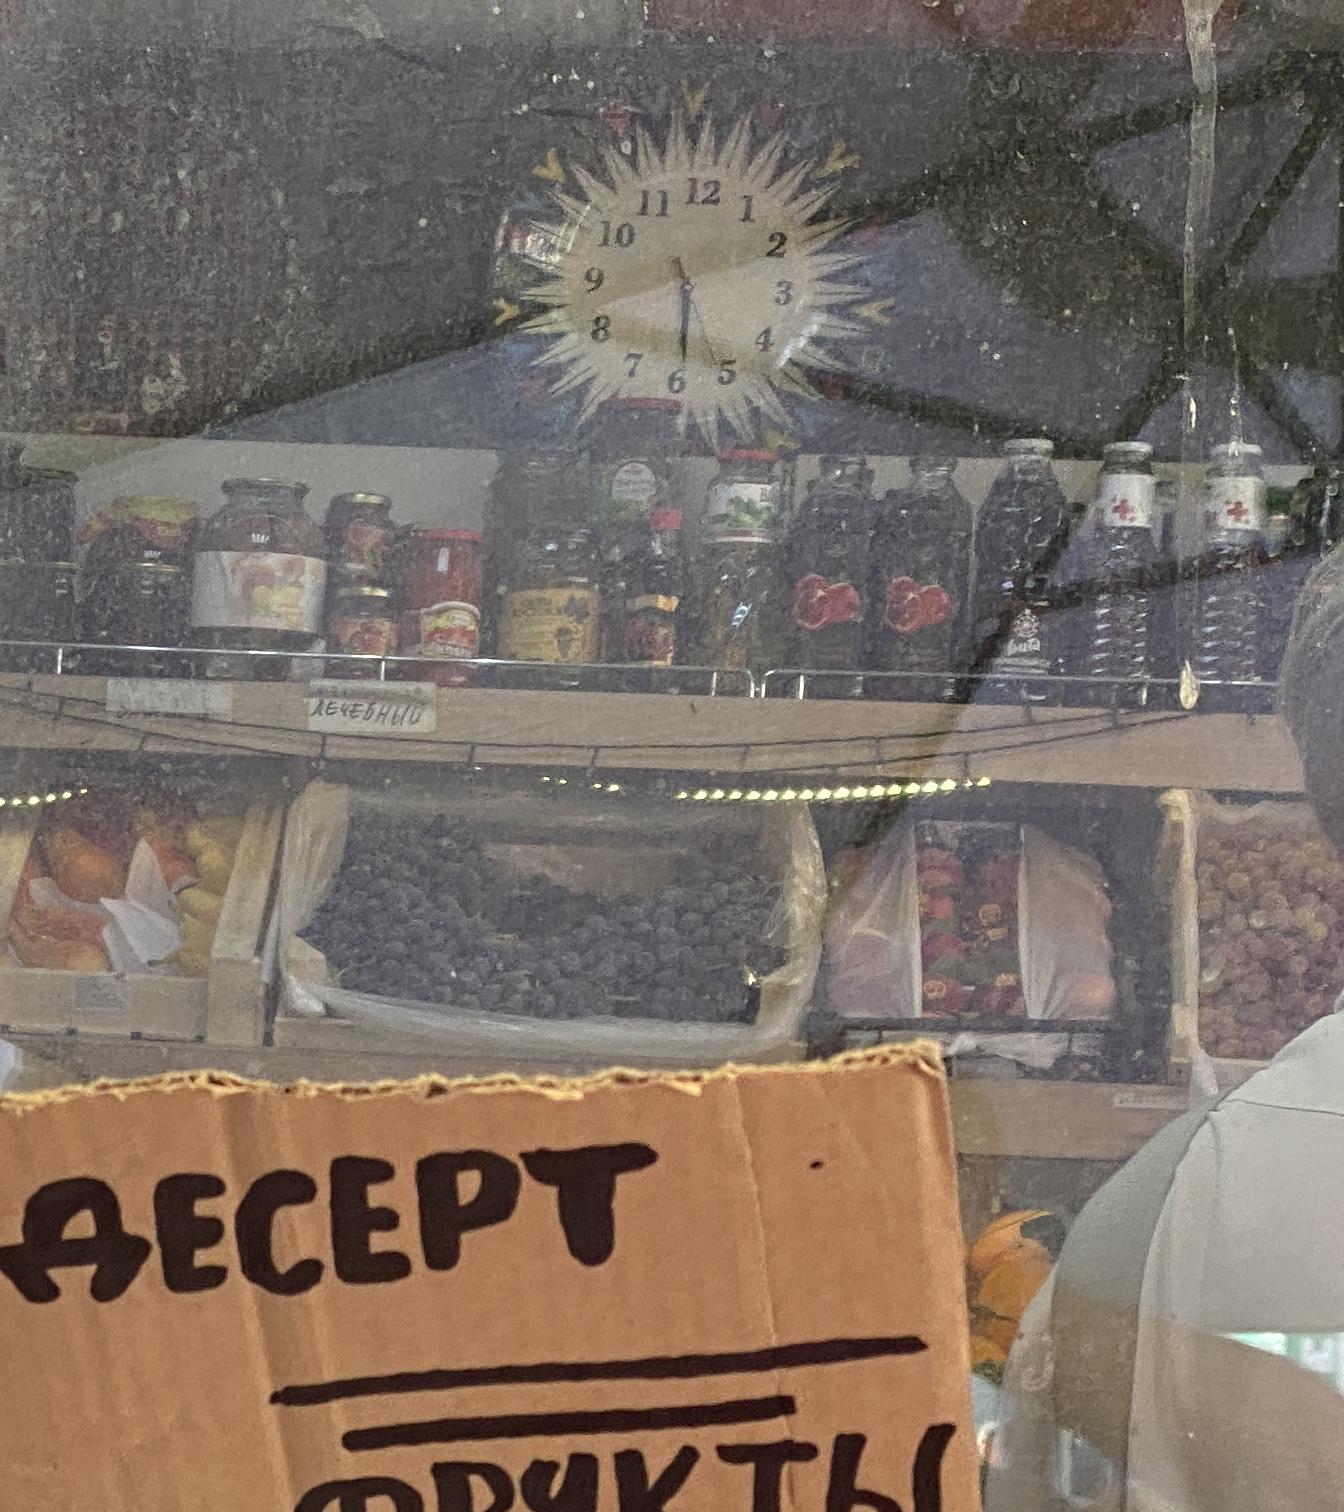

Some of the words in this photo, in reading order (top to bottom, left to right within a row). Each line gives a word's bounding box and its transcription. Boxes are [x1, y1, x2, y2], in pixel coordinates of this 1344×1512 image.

[637, 189, 671, 218] 11
[684, 177, 722, 207] 12
[739, 194, 756, 224] 1
[598, 219, 637, 249] 10
[765, 230, 789, 259] 2
[584, 266, 605, 293] 9
[774, 280, 794, 307] 3
[590, 314, 611, 344] 8
[754, 326, 775, 353] 4
[623, 351, 644, 378] 7
[666, 367, 688, 394] 6
